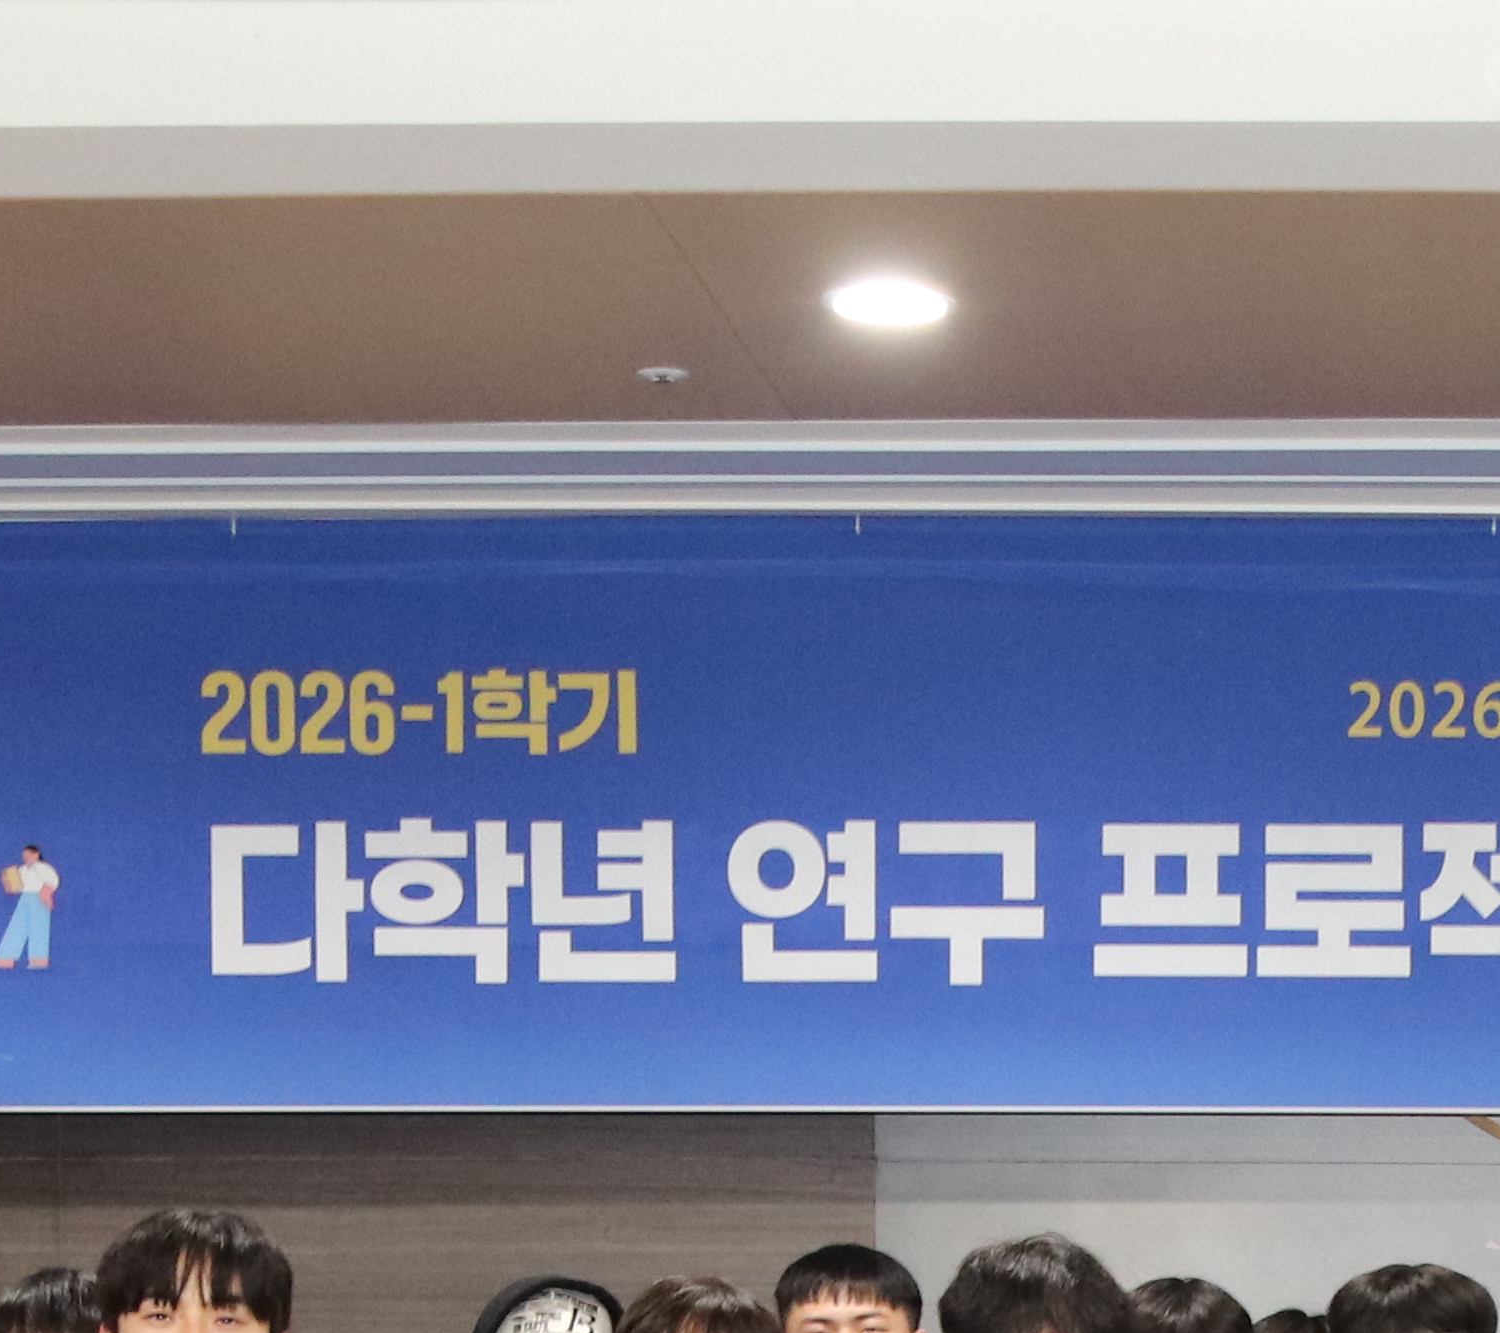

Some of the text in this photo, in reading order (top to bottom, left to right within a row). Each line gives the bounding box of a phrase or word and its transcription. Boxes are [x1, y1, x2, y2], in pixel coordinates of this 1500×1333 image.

[201, 669, 637, 755] 2026-1학기
[211, 818, 676, 984] 다학년
[728, 820, 1044, 985] 연구
